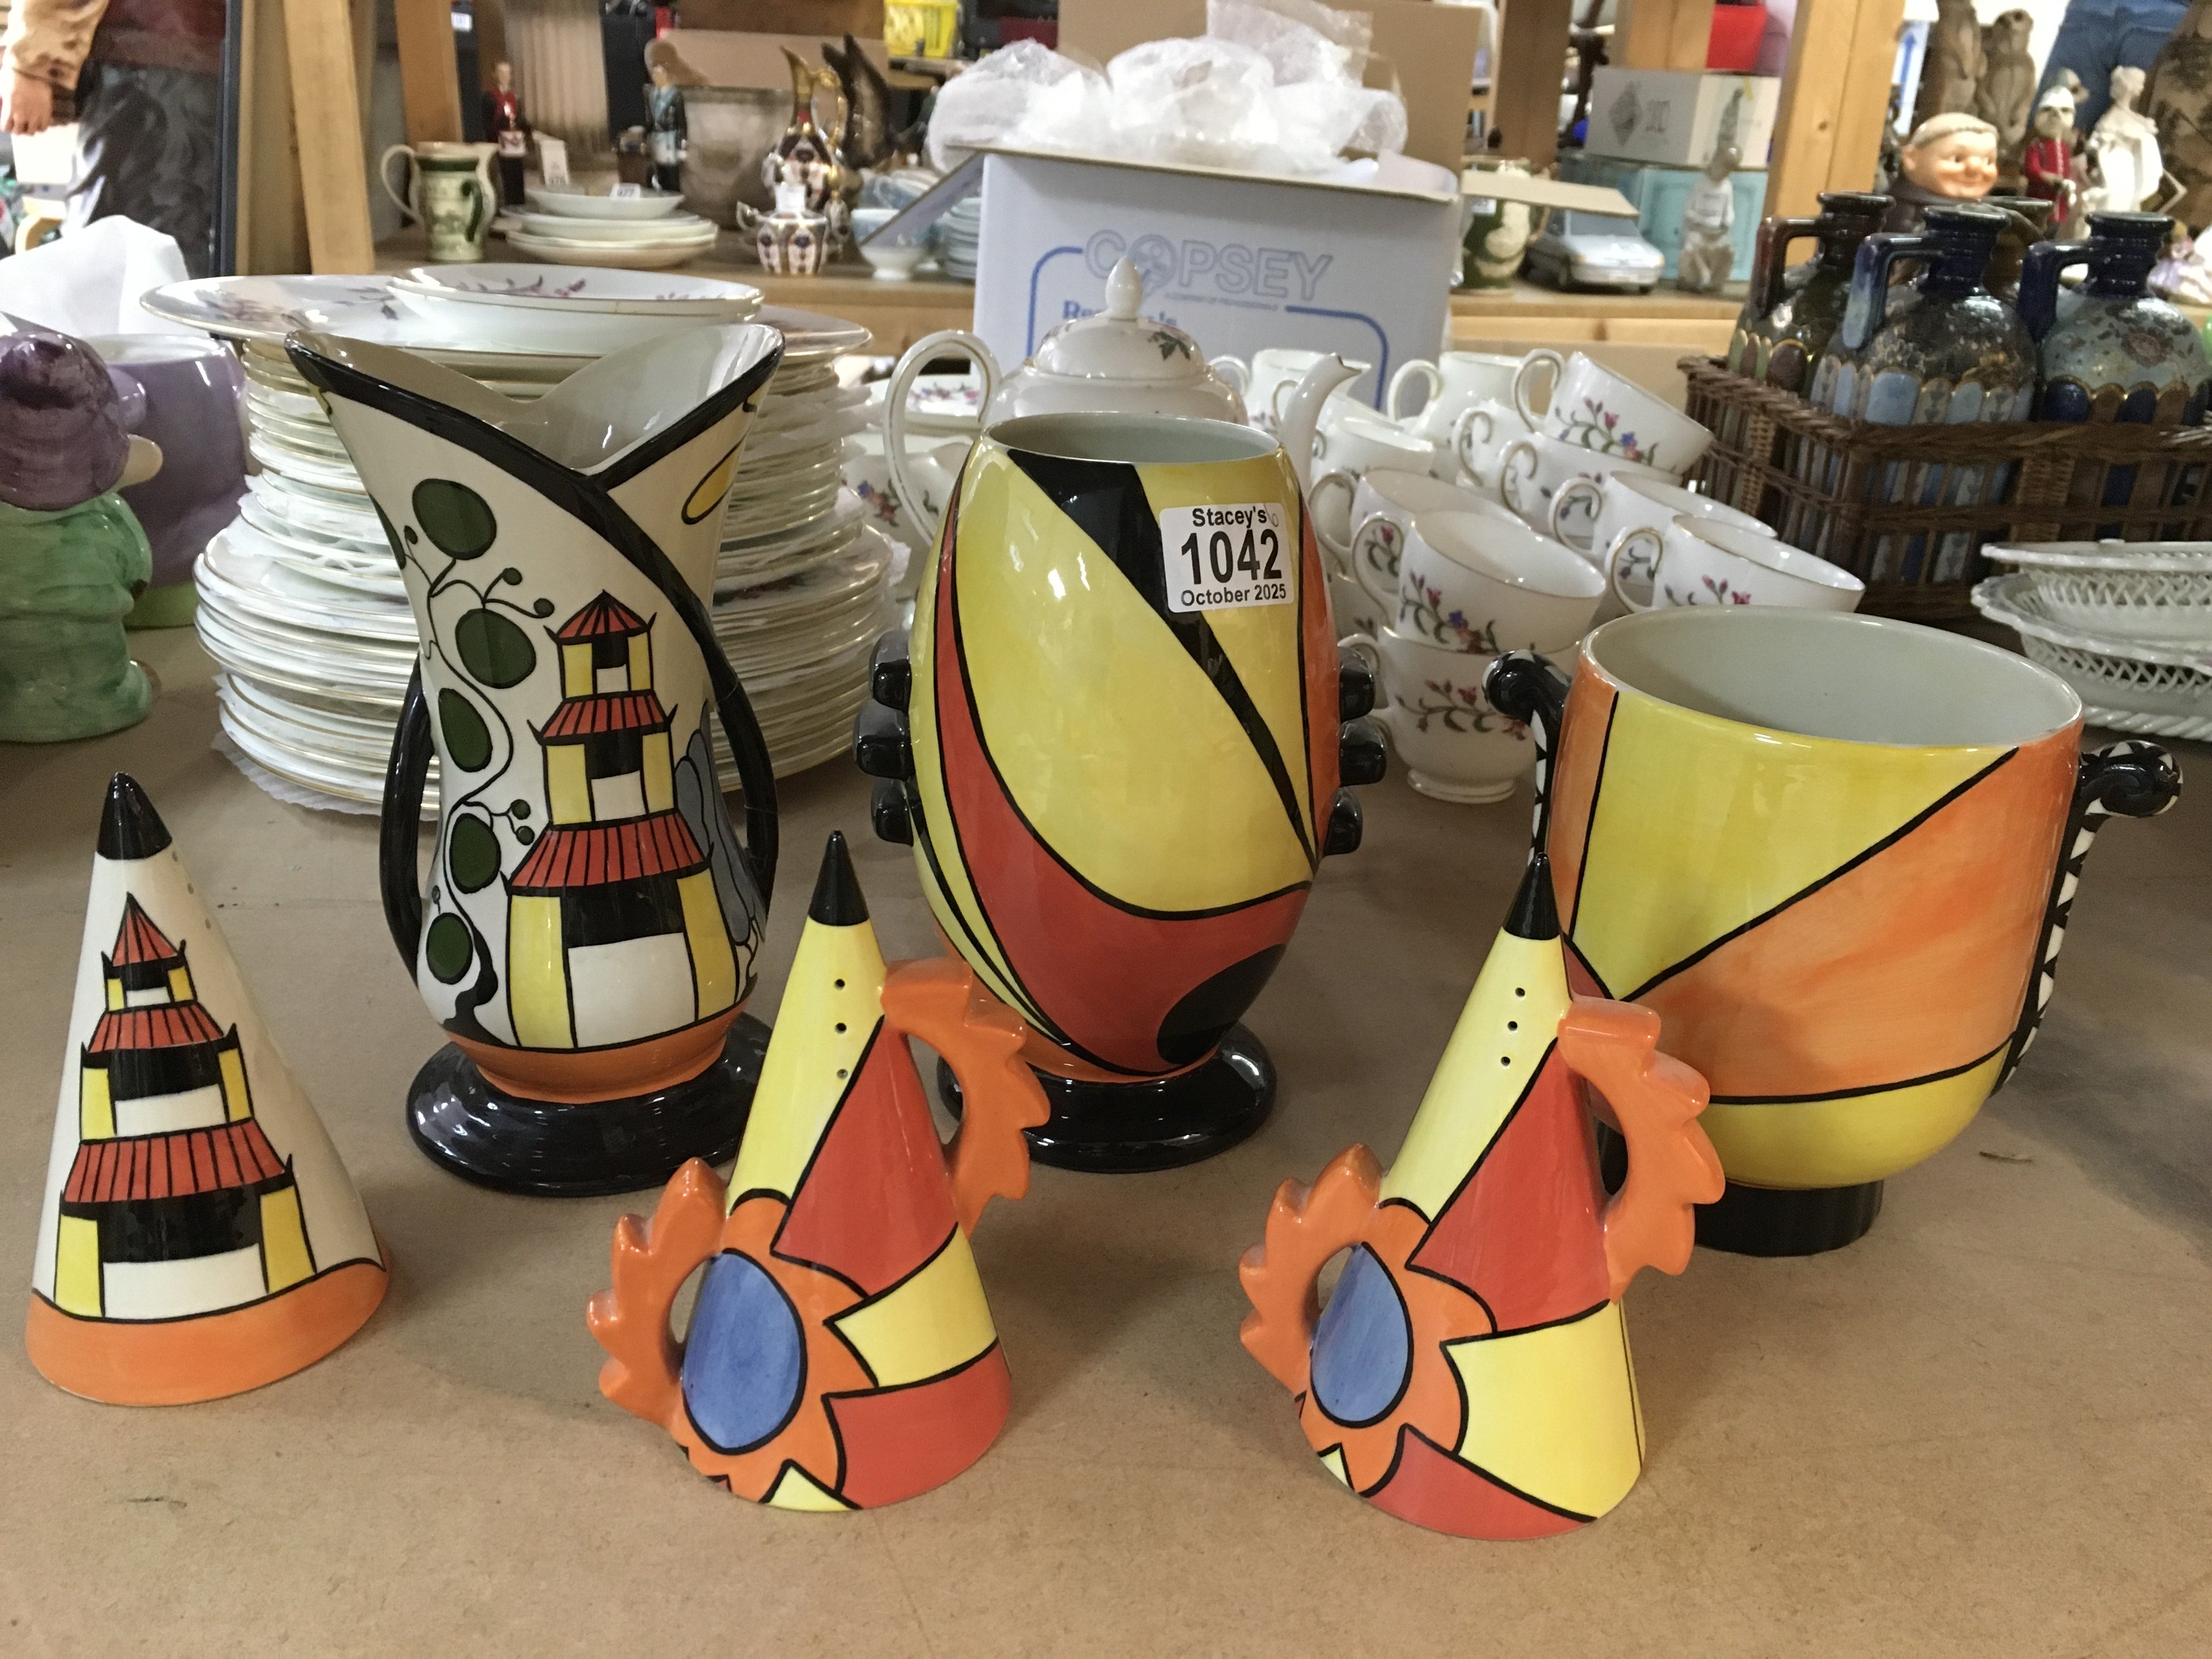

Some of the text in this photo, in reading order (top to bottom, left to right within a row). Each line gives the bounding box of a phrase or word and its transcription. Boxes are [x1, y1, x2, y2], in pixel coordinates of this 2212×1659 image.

[1192, 506, 1267, 528] Stacey's
[1181, 529, 1282, 585] 1042
[1181, 584, 1286, 606] October 2025
